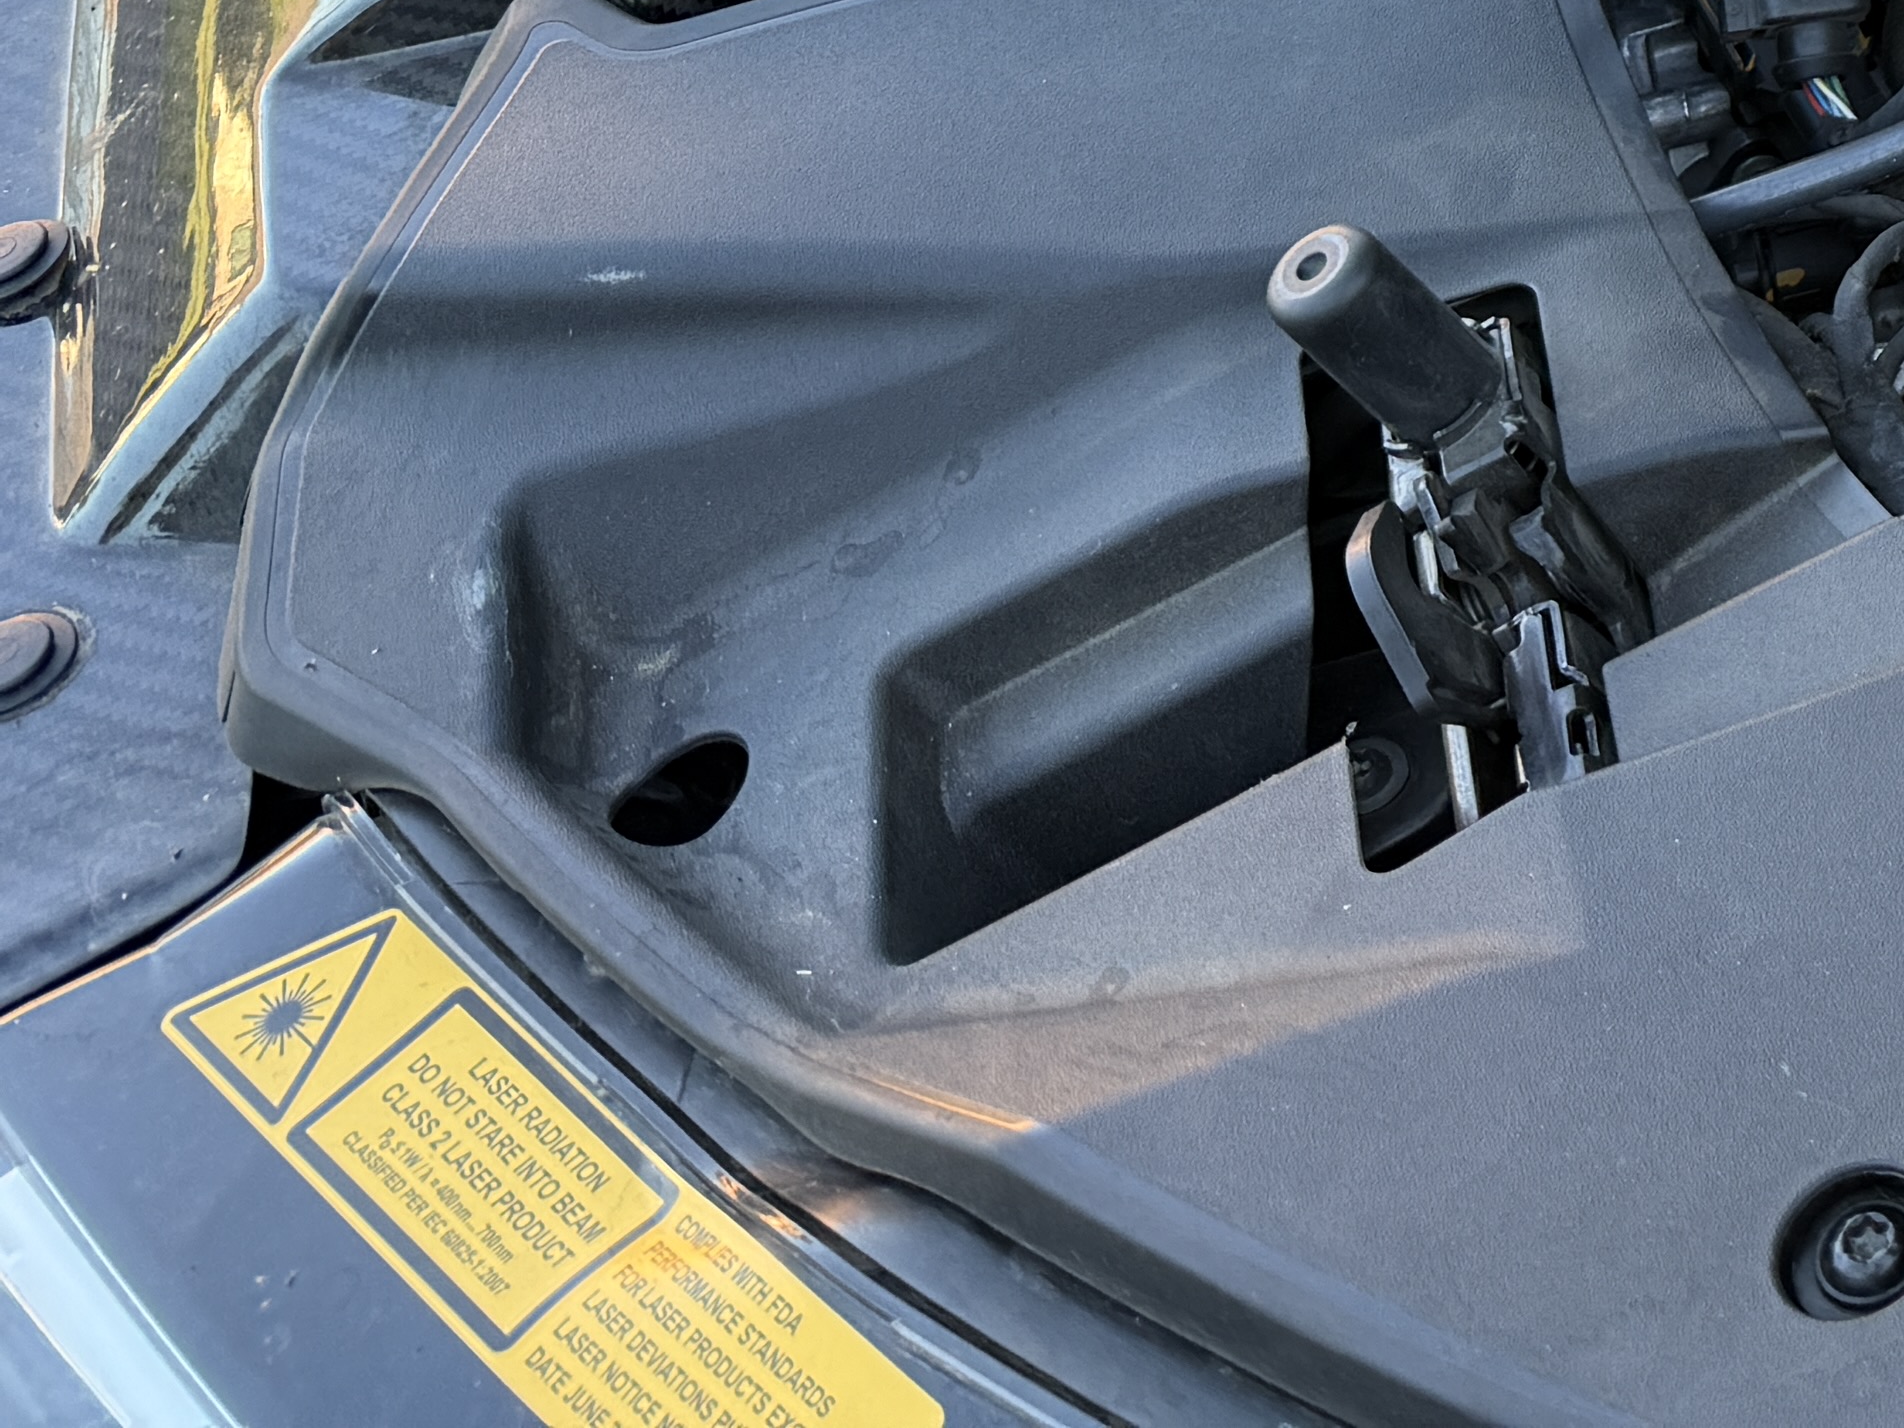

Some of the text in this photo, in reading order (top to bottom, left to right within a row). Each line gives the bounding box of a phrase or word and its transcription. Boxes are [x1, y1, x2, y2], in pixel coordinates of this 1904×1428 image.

[342, 1130, 408, 1194] CLASSIFIED
[398, 1186, 430, 1217] PER
[420, 1209, 448, 1235] IEC
[381, 1082, 576, 1269] CLASS 2 LASER PRODUCT
[406, 1052, 608, 1245] DO NOT STARE INTO BEAM
[467, 1056, 613, 1195] LASER RADIATION
[612, 1263, 648, 1299] FOR
[637, 1286, 692, 1342] LASER
[682, 1327, 773, 1416] PRODUCTS
[642, 1239, 837, 1419] PERFORMANCE STANDARDS
[674, 1214, 804, 1337] COMPLIES WITH FDA
[526, 1344, 612, 1425] DATE JUNE
[552, 1316, 608, 1374] LASER
[598, 1359, 663, 1427] NOTICE
[581, 1288, 635, 1344] LASER
[625, 1329, 719, 1423] DEVIATIONS
